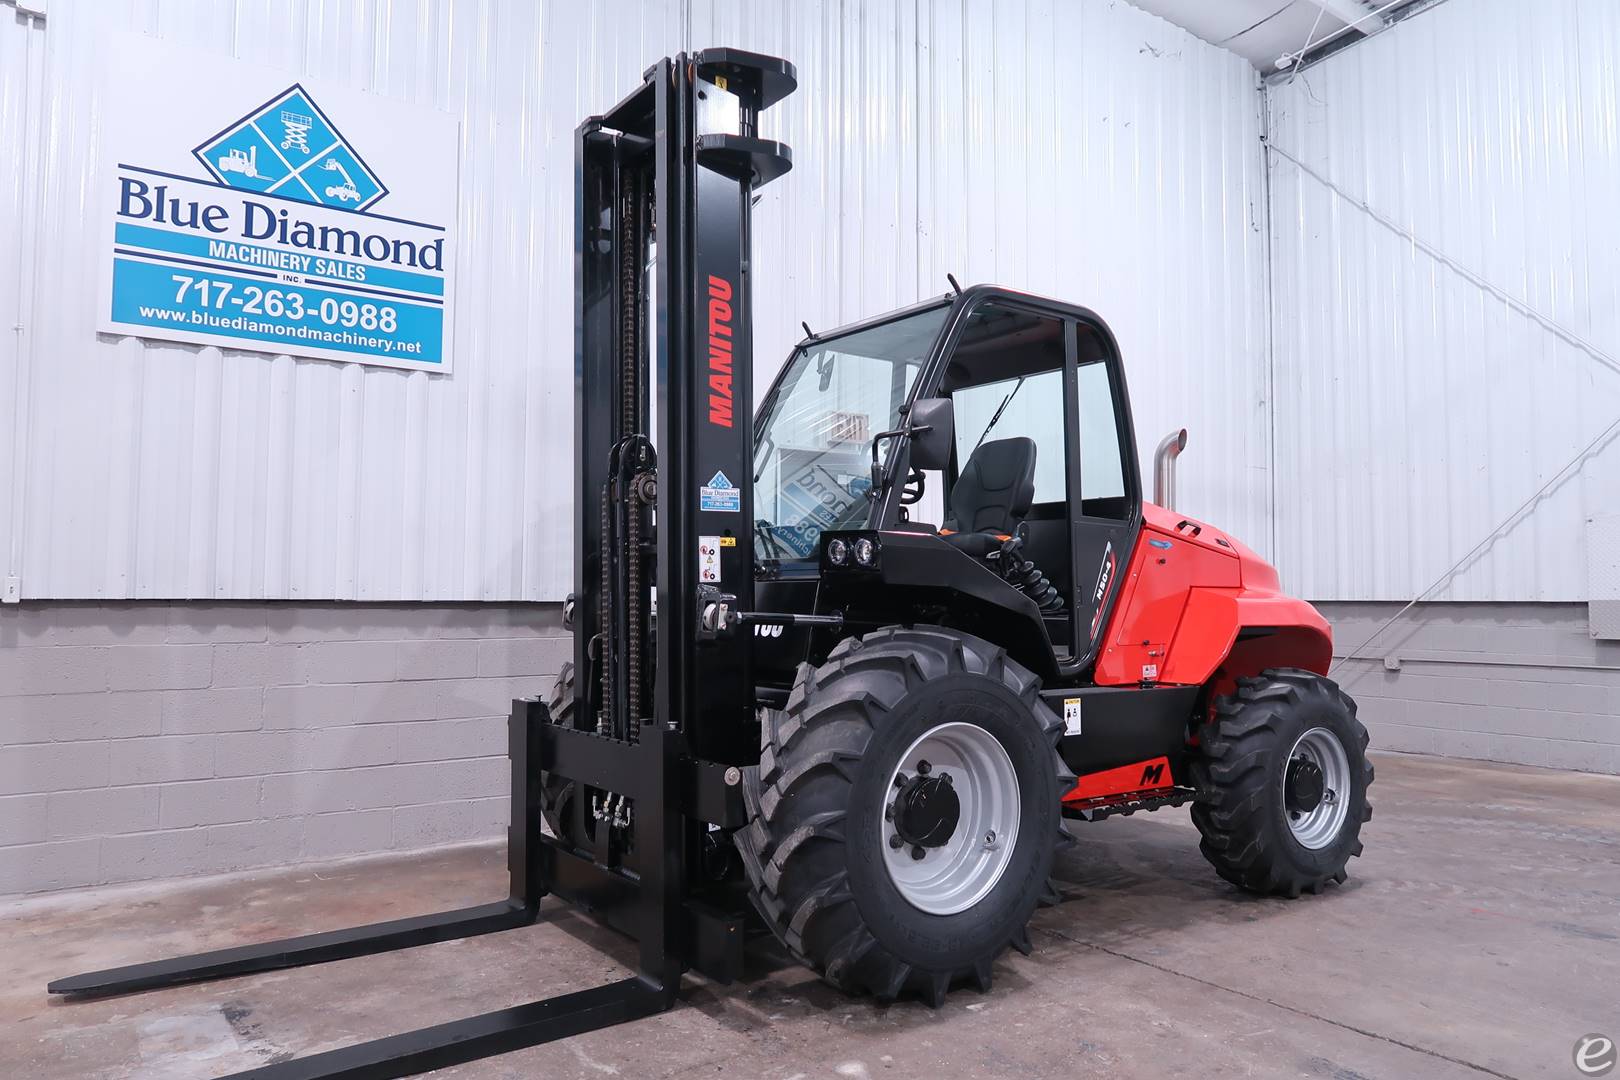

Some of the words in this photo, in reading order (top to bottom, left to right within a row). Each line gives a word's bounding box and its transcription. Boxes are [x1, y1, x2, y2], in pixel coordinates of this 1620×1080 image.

[116, 175, 230, 234] Blue
[241, 200, 445, 272] Diamond
[208, 240, 311, 272] MACHINERY
[314, 258, 367, 282] SALES
[282, 273, 302, 284] INC.
[171, 274, 398, 333] 717-263-0988
[138, 305, 422, 354] www.bluediamondmachinery.net
[708, 274, 733, 428] MANITOU
[714, 489, 739, 497] Diamond
[1096, 561, 1112, 600] M50-4
